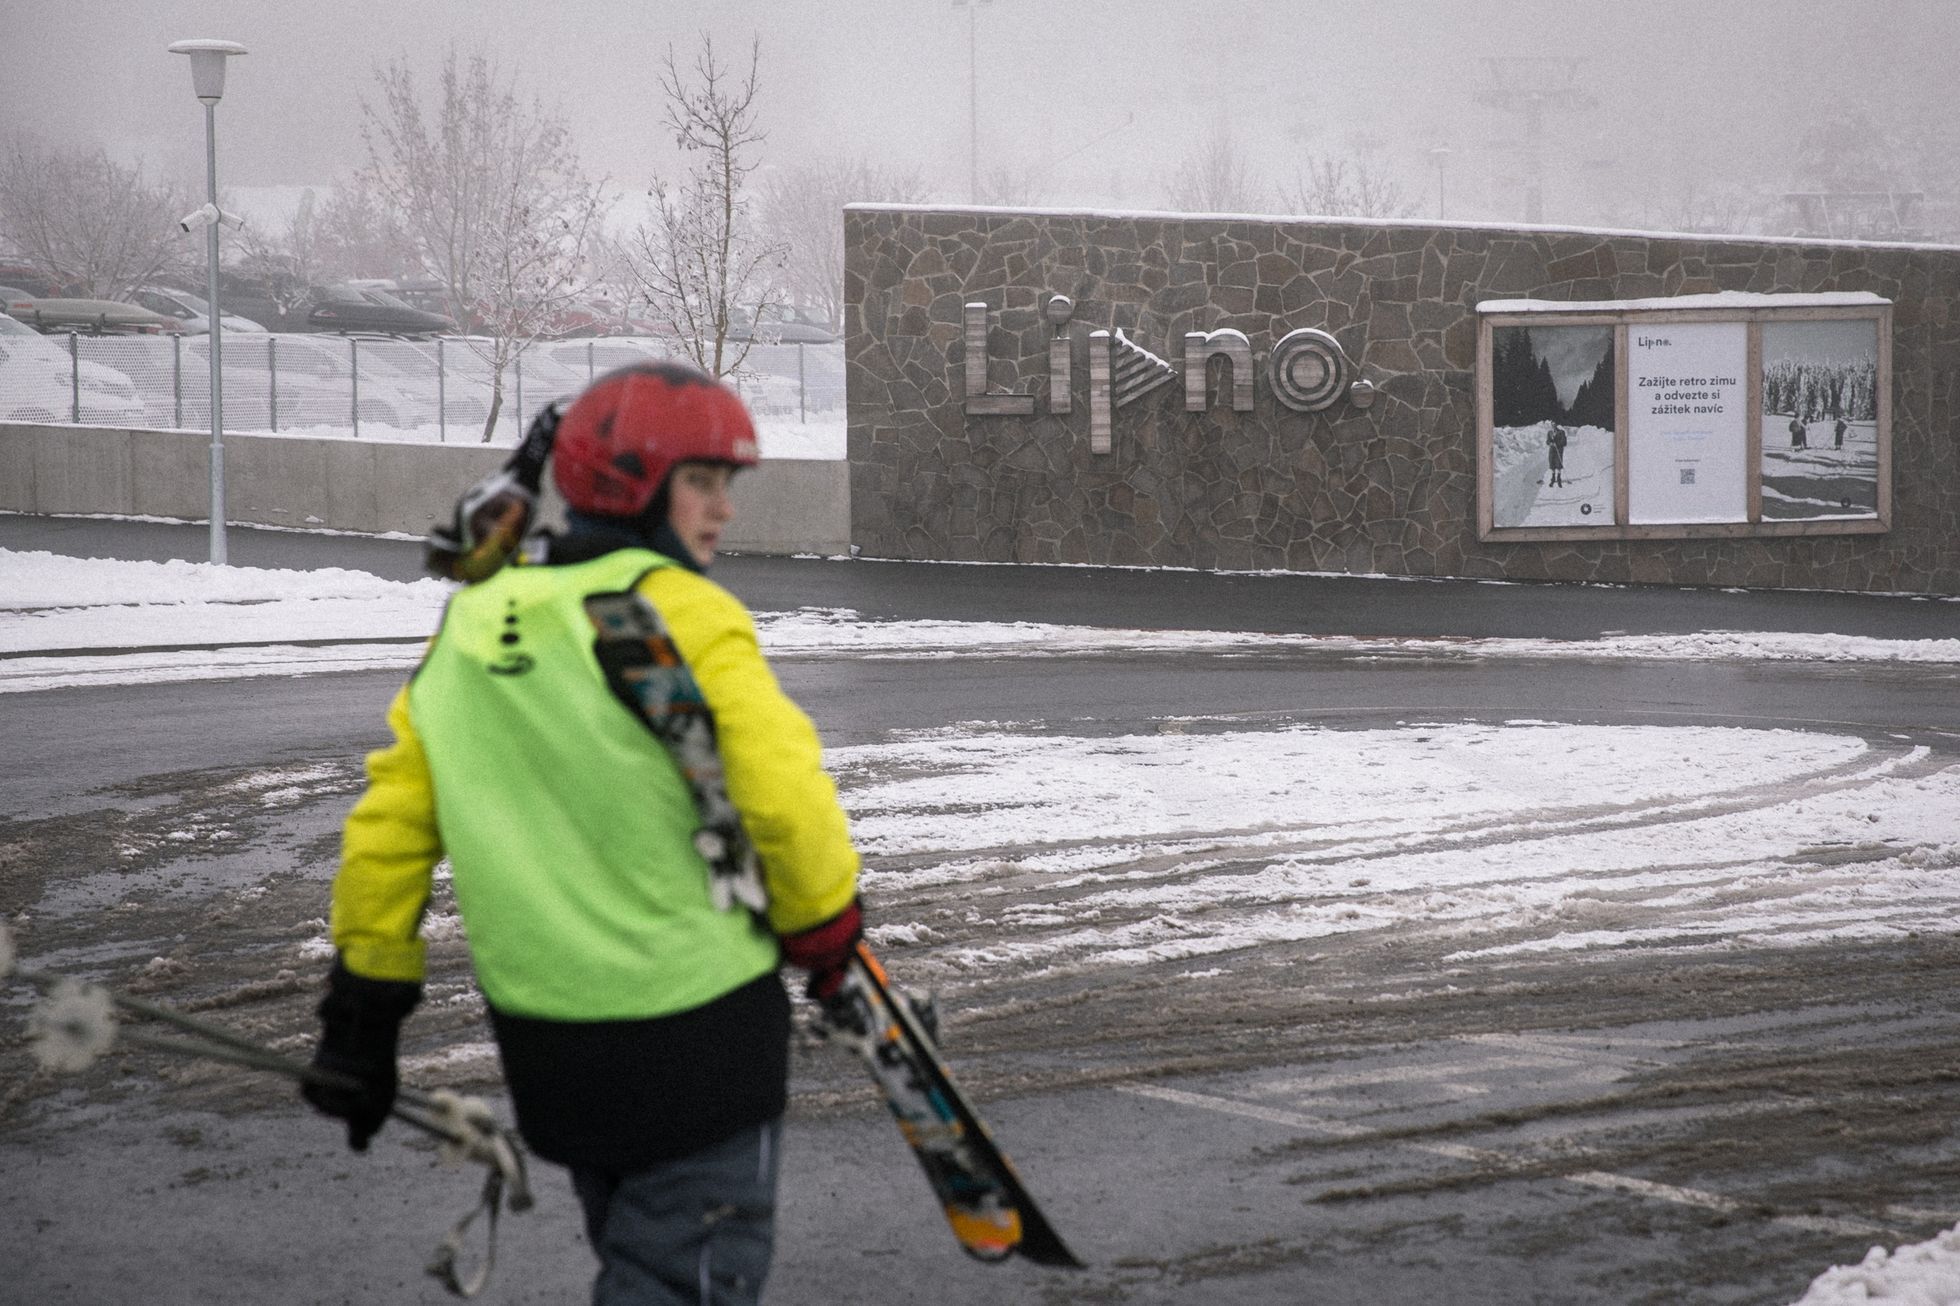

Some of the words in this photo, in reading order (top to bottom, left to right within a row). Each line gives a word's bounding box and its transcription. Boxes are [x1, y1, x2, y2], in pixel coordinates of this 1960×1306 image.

[1638, 376, 1676, 389] Zažijte
[1679, 377, 1707, 387] retro
[1709, 375, 1736, 386] zimu
[1654, 393, 1661, 401] a
[1664, 390, 1709, 401] odvezte
[1711, 390, 1720, 399] si
[1651, 404, 1691, 415] zážitek
[1693, 403, 1724, 414] navíc
